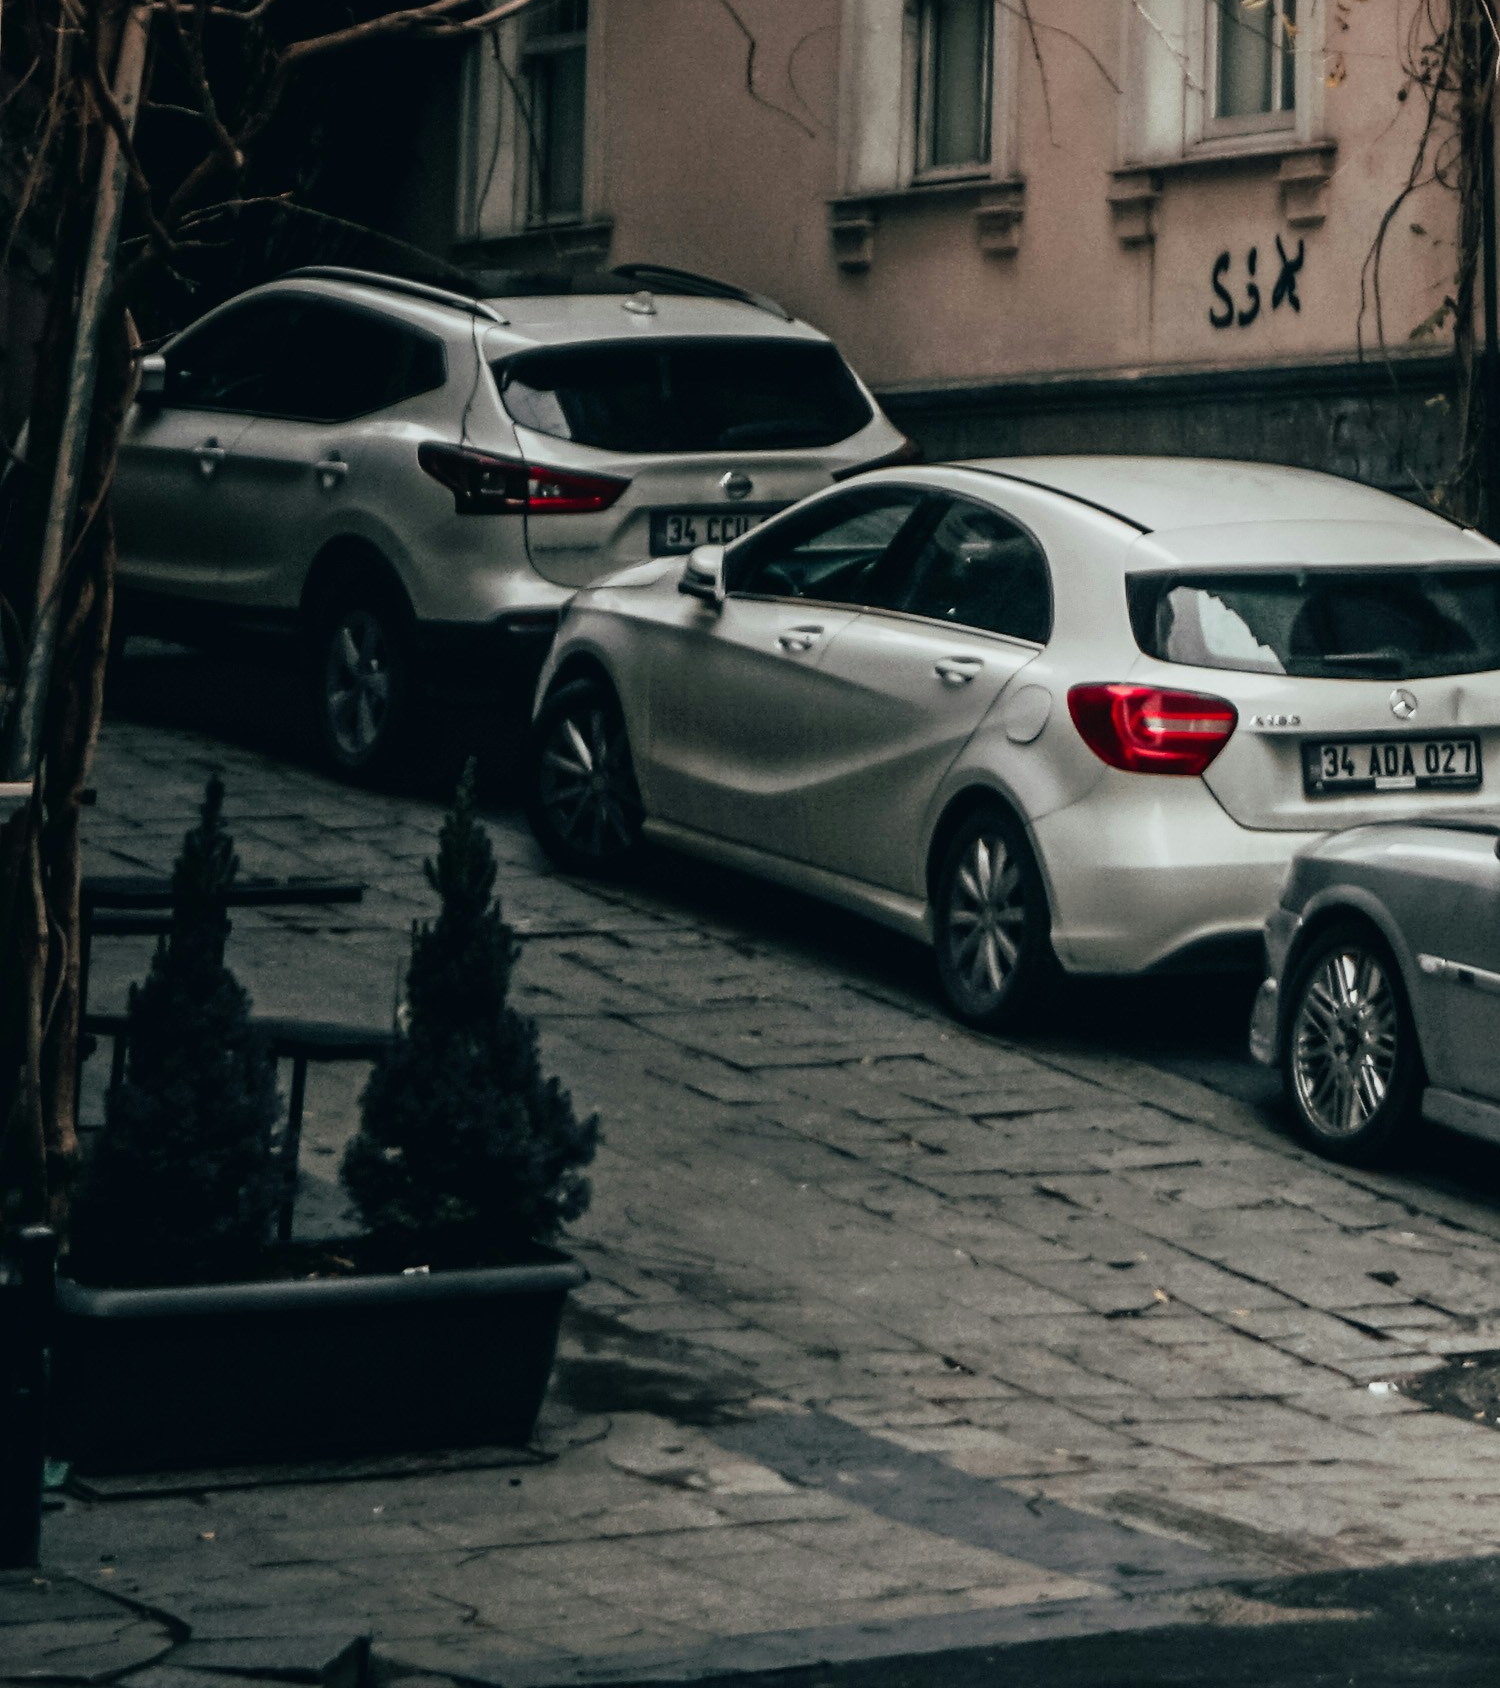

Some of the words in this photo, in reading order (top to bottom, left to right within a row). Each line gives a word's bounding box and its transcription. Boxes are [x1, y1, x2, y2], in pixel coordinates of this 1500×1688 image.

[668, 516, 697, 544] 34
[1322, 746, 1355, 778] 34
[1424, 742, 1472, 774] 027
